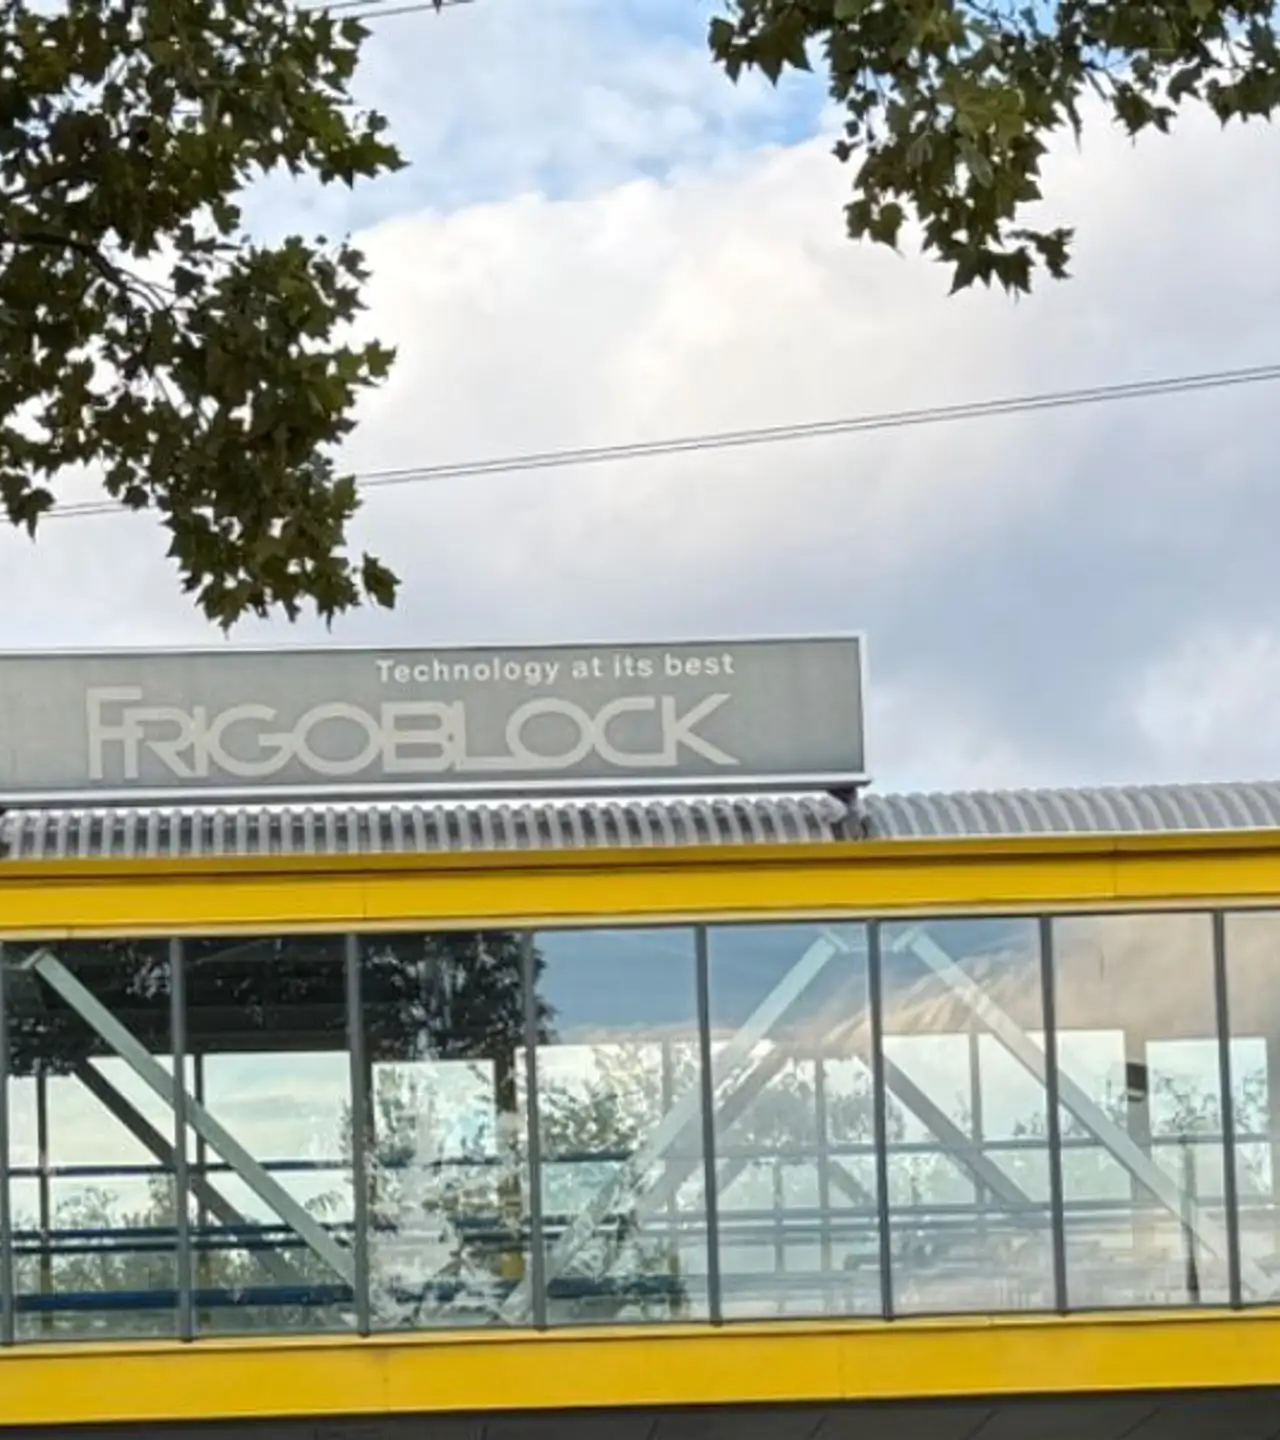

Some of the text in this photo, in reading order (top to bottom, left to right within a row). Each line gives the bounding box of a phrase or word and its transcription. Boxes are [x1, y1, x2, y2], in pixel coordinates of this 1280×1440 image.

[375, 656, 560, 687] Technology
[572, 654, 605, 679] at
[664, 652, 735, 676] best
[85, 686, 742, 780] FRIGOBLOCK
